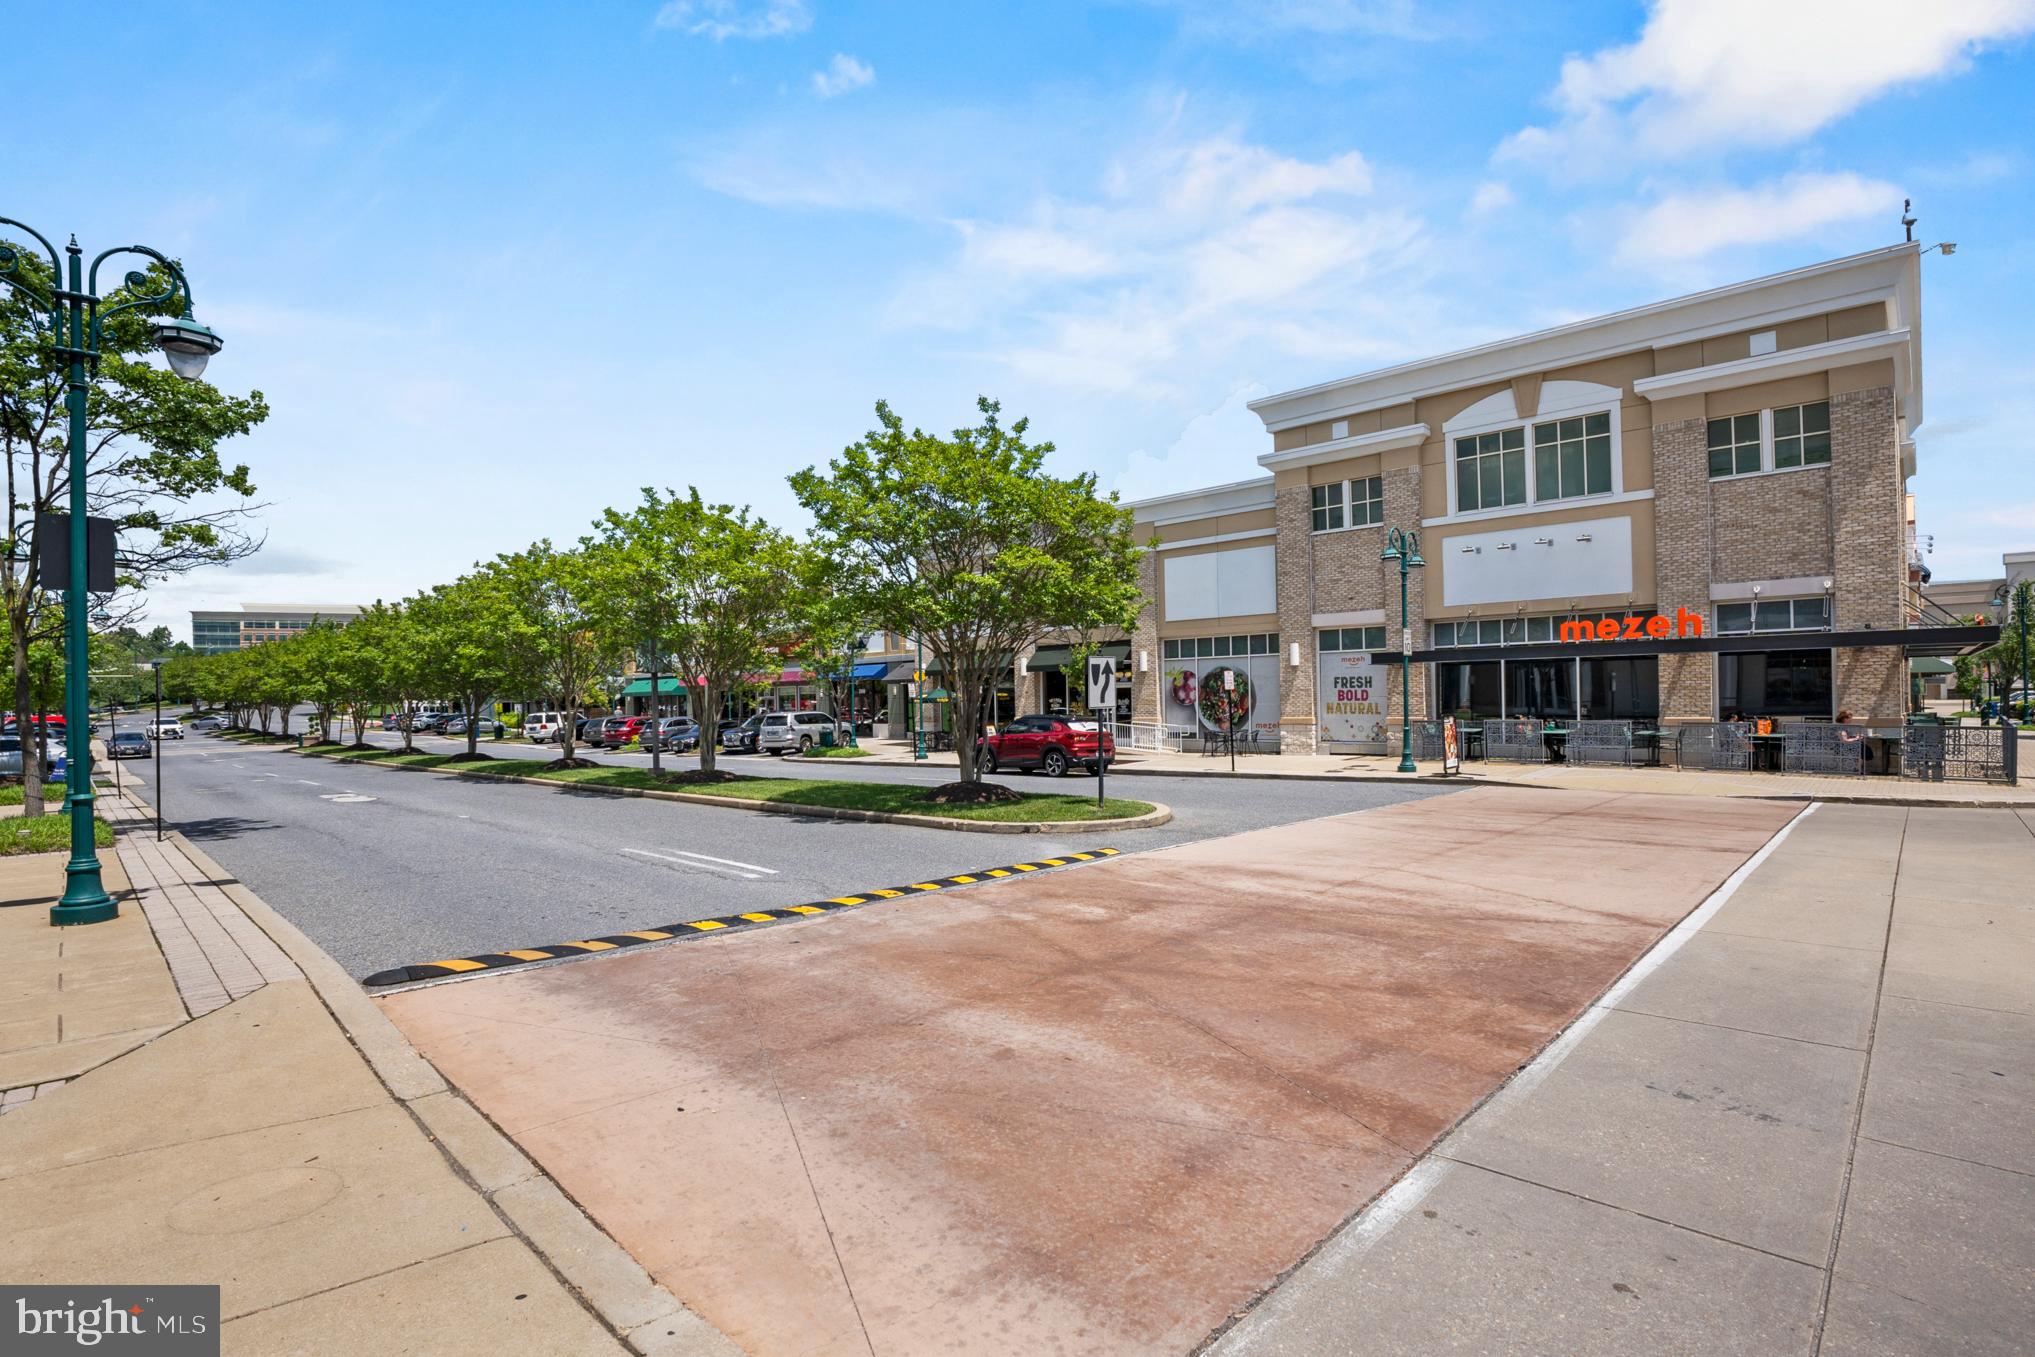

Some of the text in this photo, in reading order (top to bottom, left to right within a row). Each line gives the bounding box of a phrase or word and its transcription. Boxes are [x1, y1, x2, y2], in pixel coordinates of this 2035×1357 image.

[1560, 607, 1702, 643] mezeh
[1333, 676, 1372, 688] FRESH
[1337, 689, 1369, 701] BOLD
[1326, 703, 1381, 714] NATURAL
